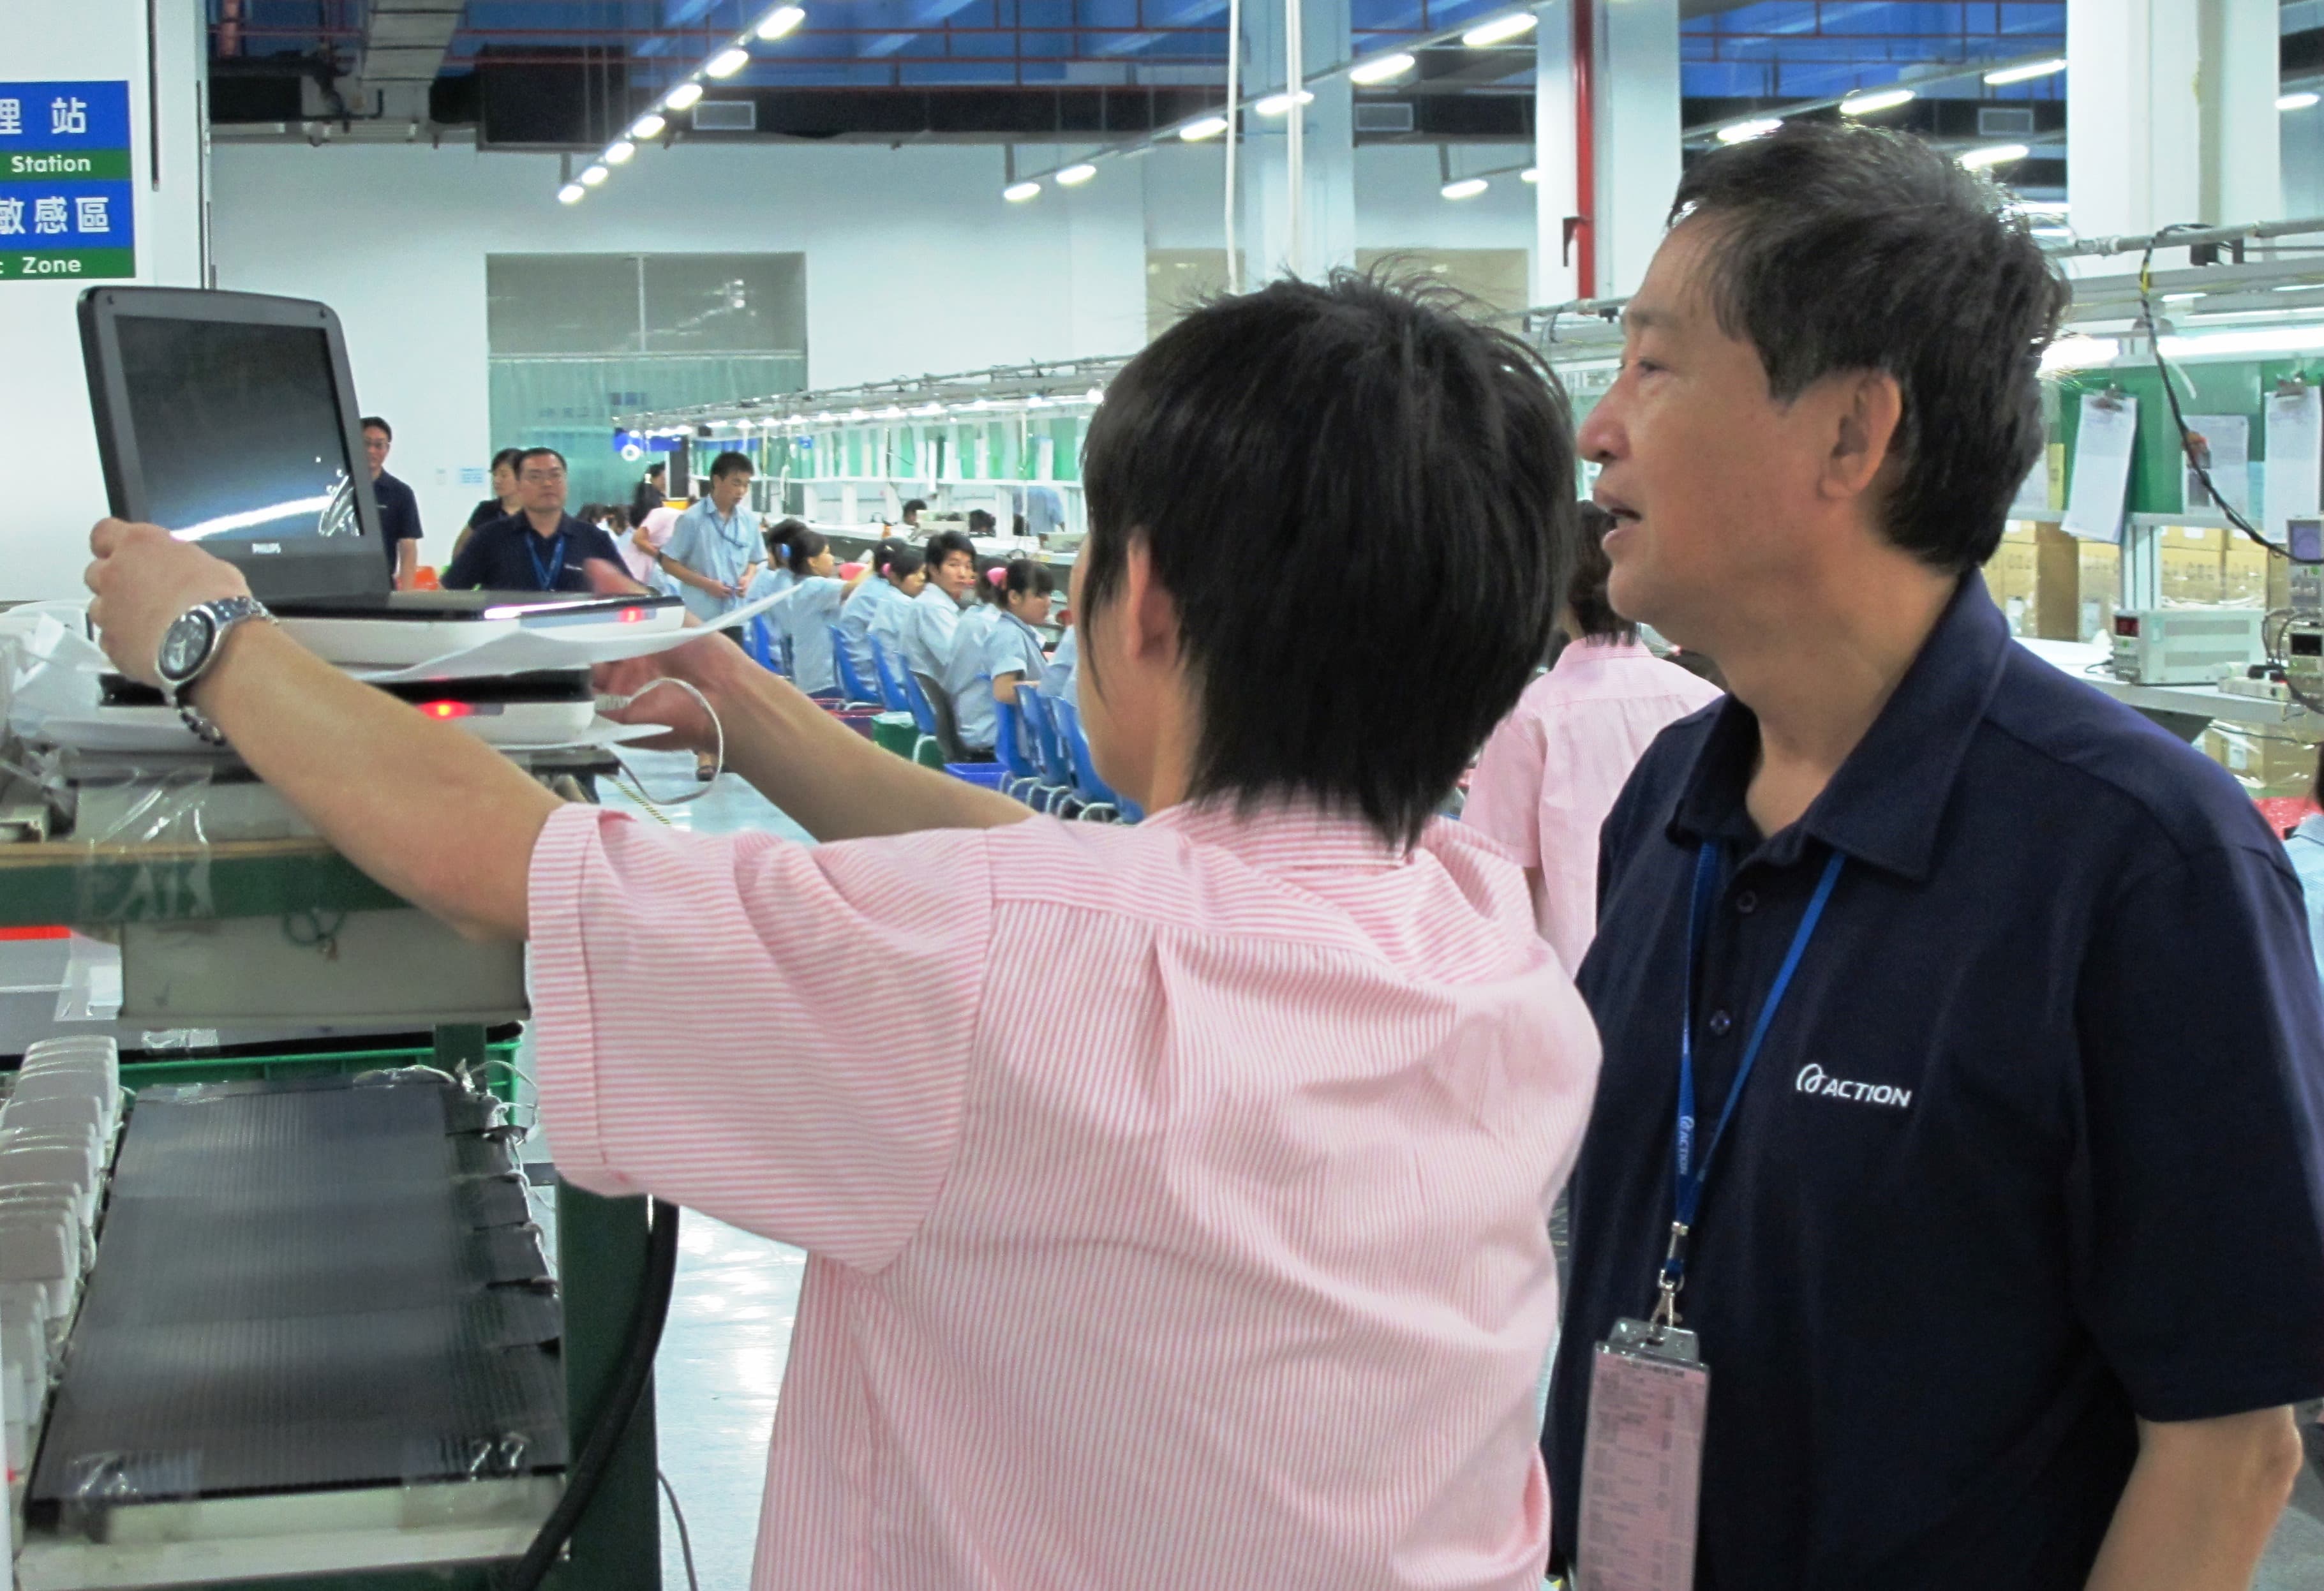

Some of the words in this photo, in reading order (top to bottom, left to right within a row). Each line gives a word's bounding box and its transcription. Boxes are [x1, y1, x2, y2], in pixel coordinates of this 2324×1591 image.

[11, 154, 91, 173] Station
[22, 257, 82, 274] Zone
[1821, 1078, 1912, 1107] ACTION
